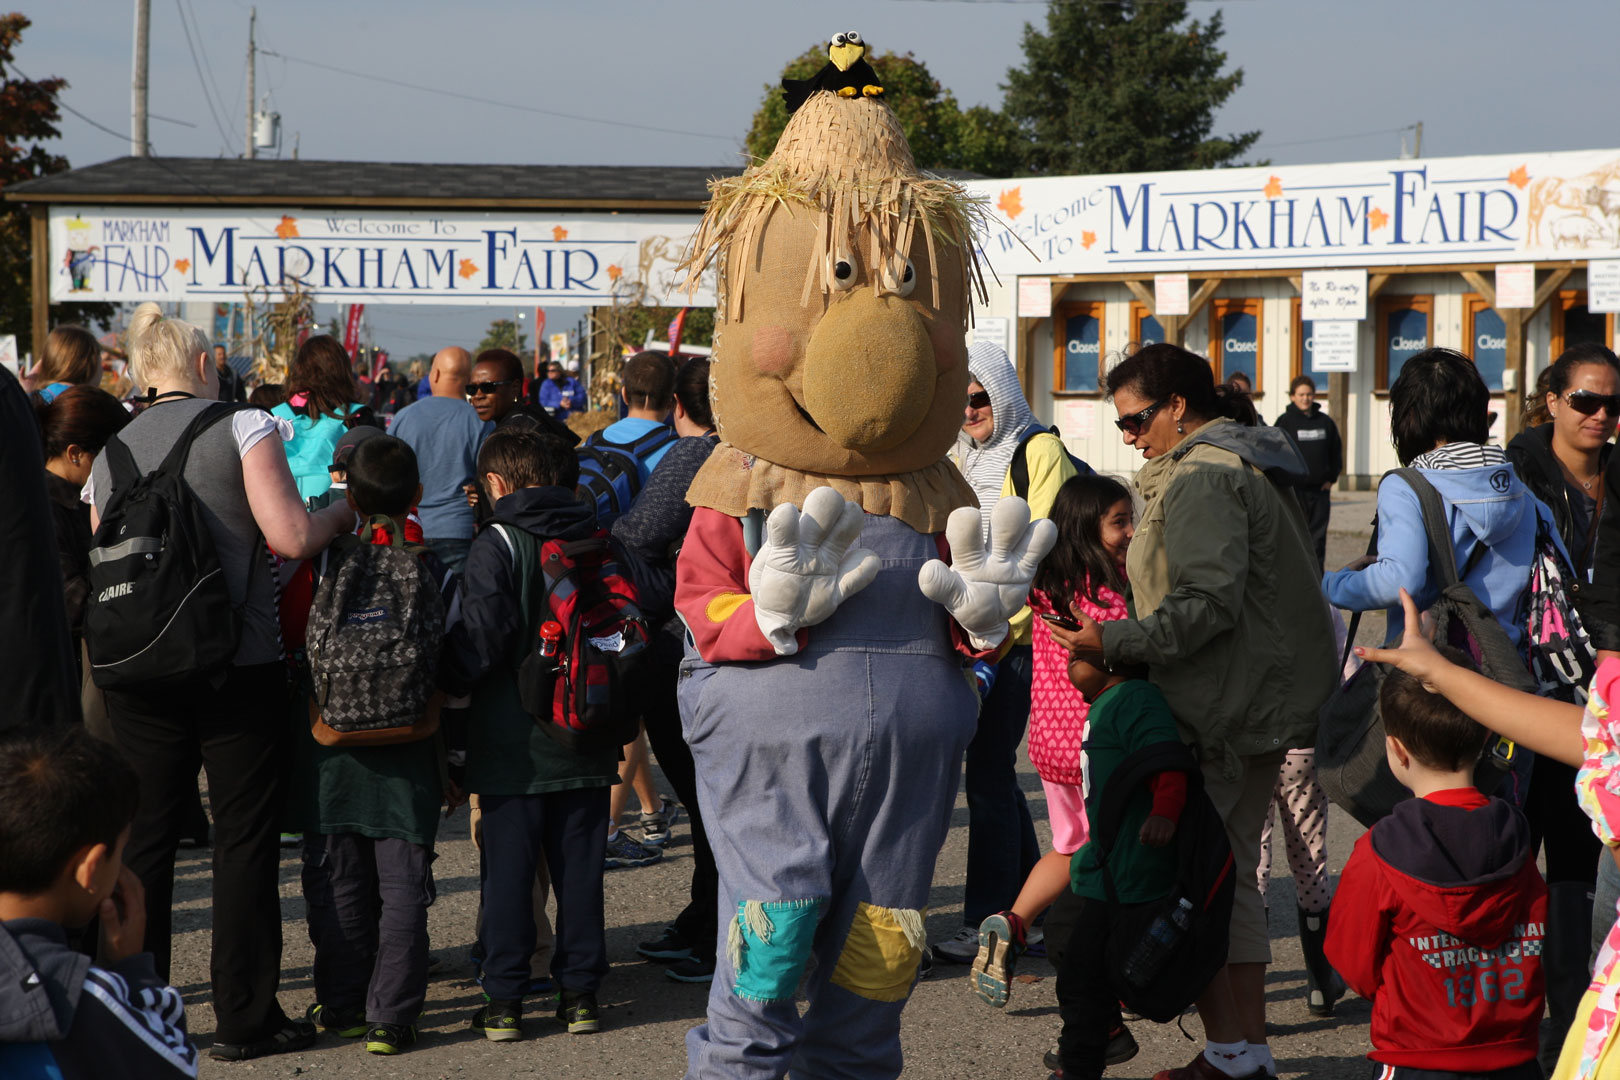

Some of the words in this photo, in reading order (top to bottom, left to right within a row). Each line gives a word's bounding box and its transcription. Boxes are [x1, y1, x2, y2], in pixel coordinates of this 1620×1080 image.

[325, 217, 421, 235] Welcome
[429, 218, 457, 235] To
[997, 187, 1104, 253] Welcome
[1104, 182, 1373, 254] MARKHAM
[1387, 165, 1520, 245] FAIR
[102, 219, 170, 242] MARKHAM
[186, 227, 459, 290] MARKHAM
[481, 226, 600, 291] FAIR
[1042, 234, 1073, 262] To
[104, 245, 170, 293] FAIR
[1068, 339, 1100, 354] Closed
[1391, 336, 1427, 351] Closed
[1443, 968, 1526, 1008] 1962
